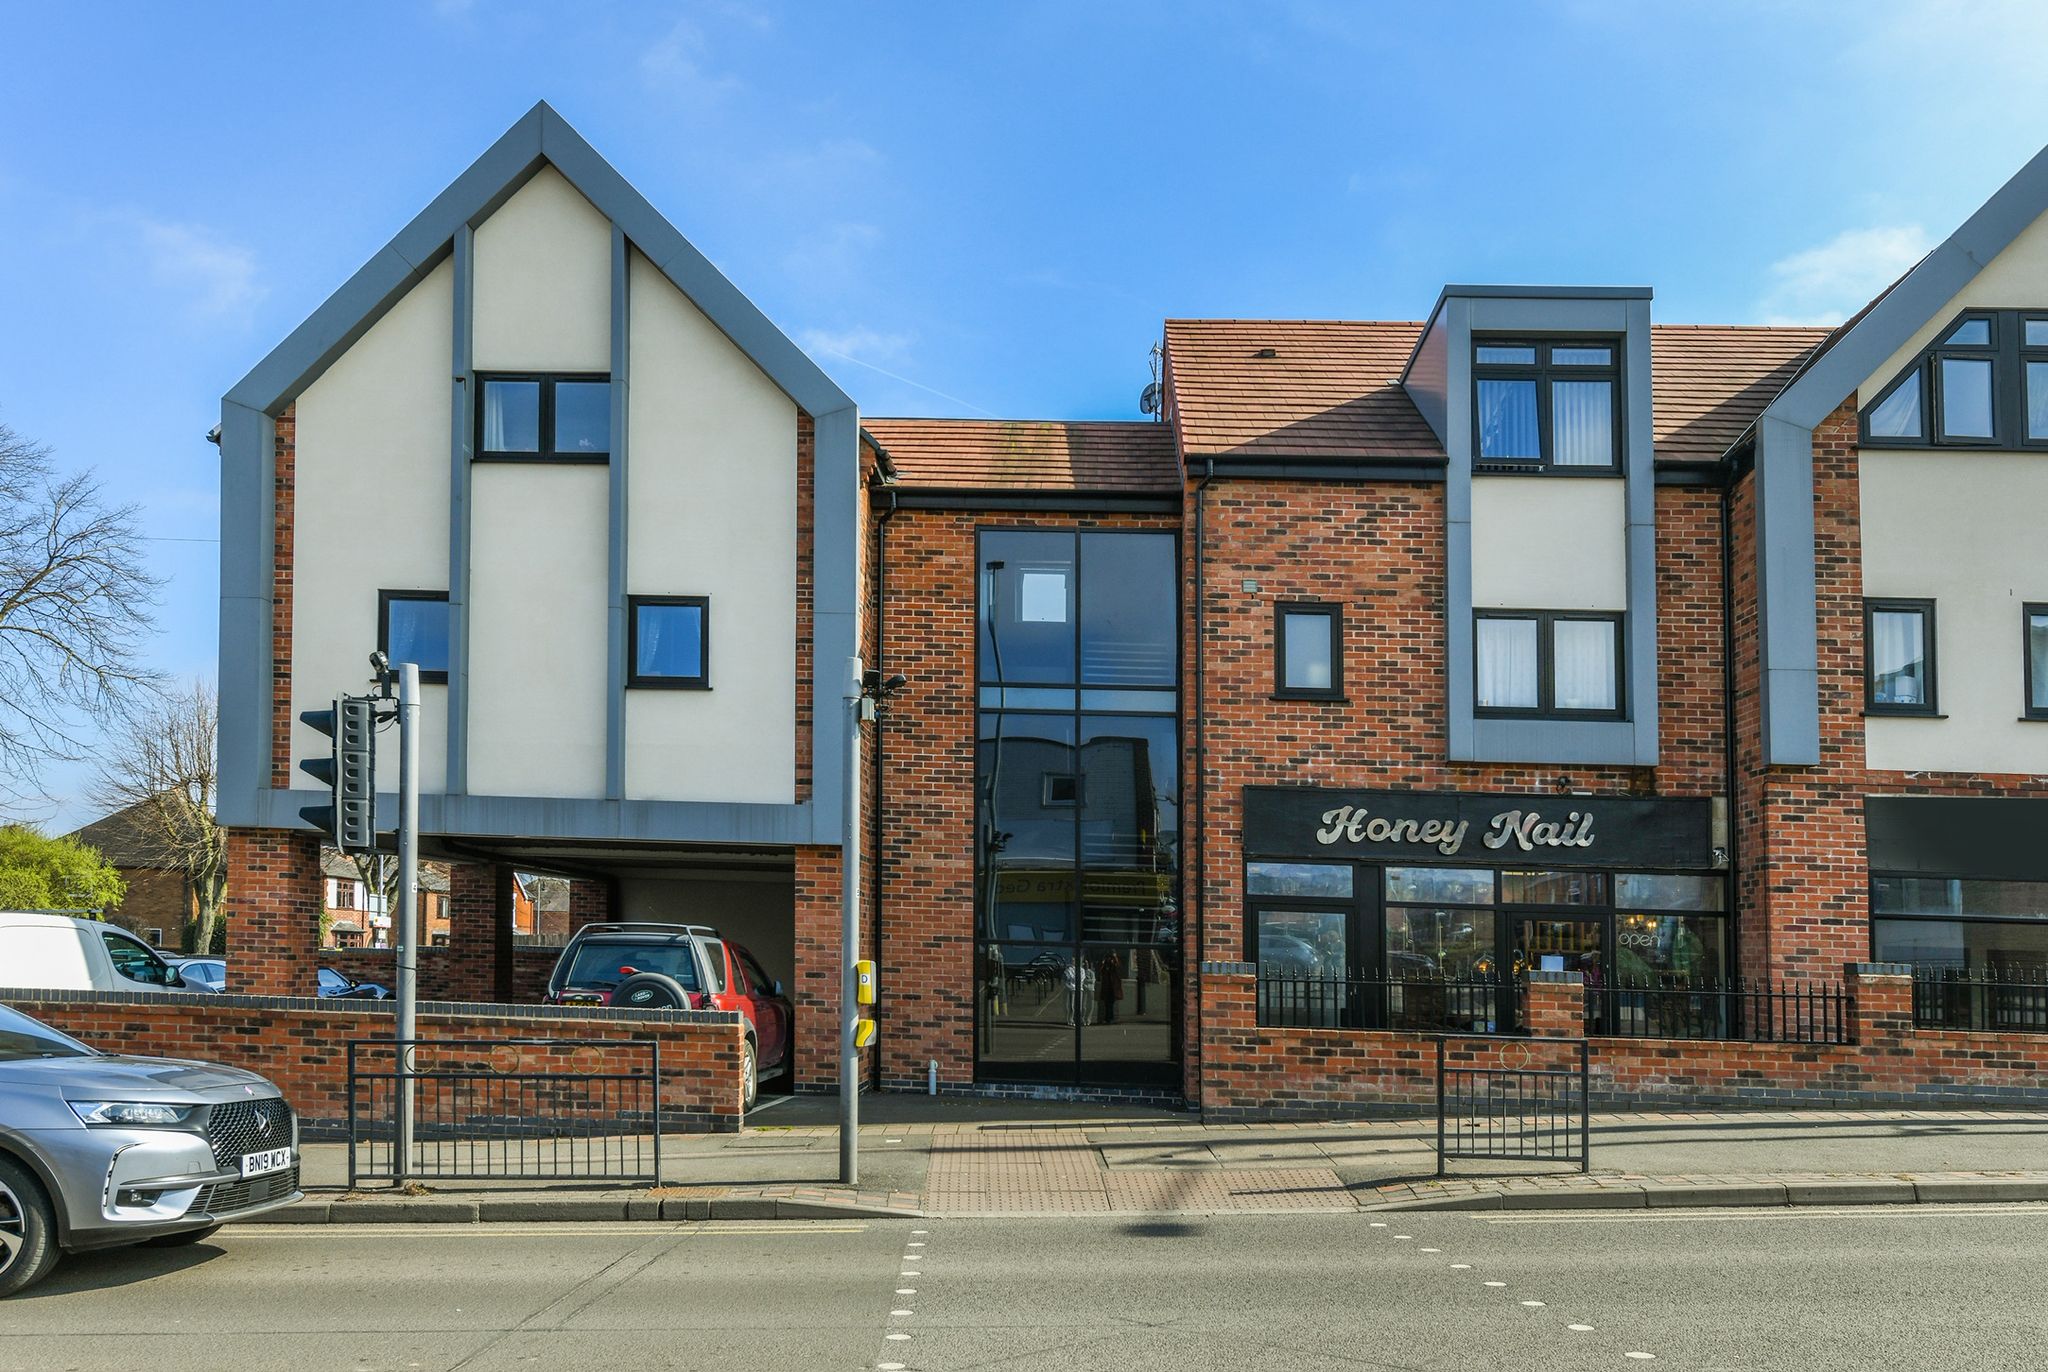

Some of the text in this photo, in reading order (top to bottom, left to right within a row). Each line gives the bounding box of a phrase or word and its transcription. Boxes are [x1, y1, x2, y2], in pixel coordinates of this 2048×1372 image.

[1316, 805, 1595, 855] Honey Nail
[1618, 933, 1660, 948] open
[249, 1153, 268, 1172] BN19
